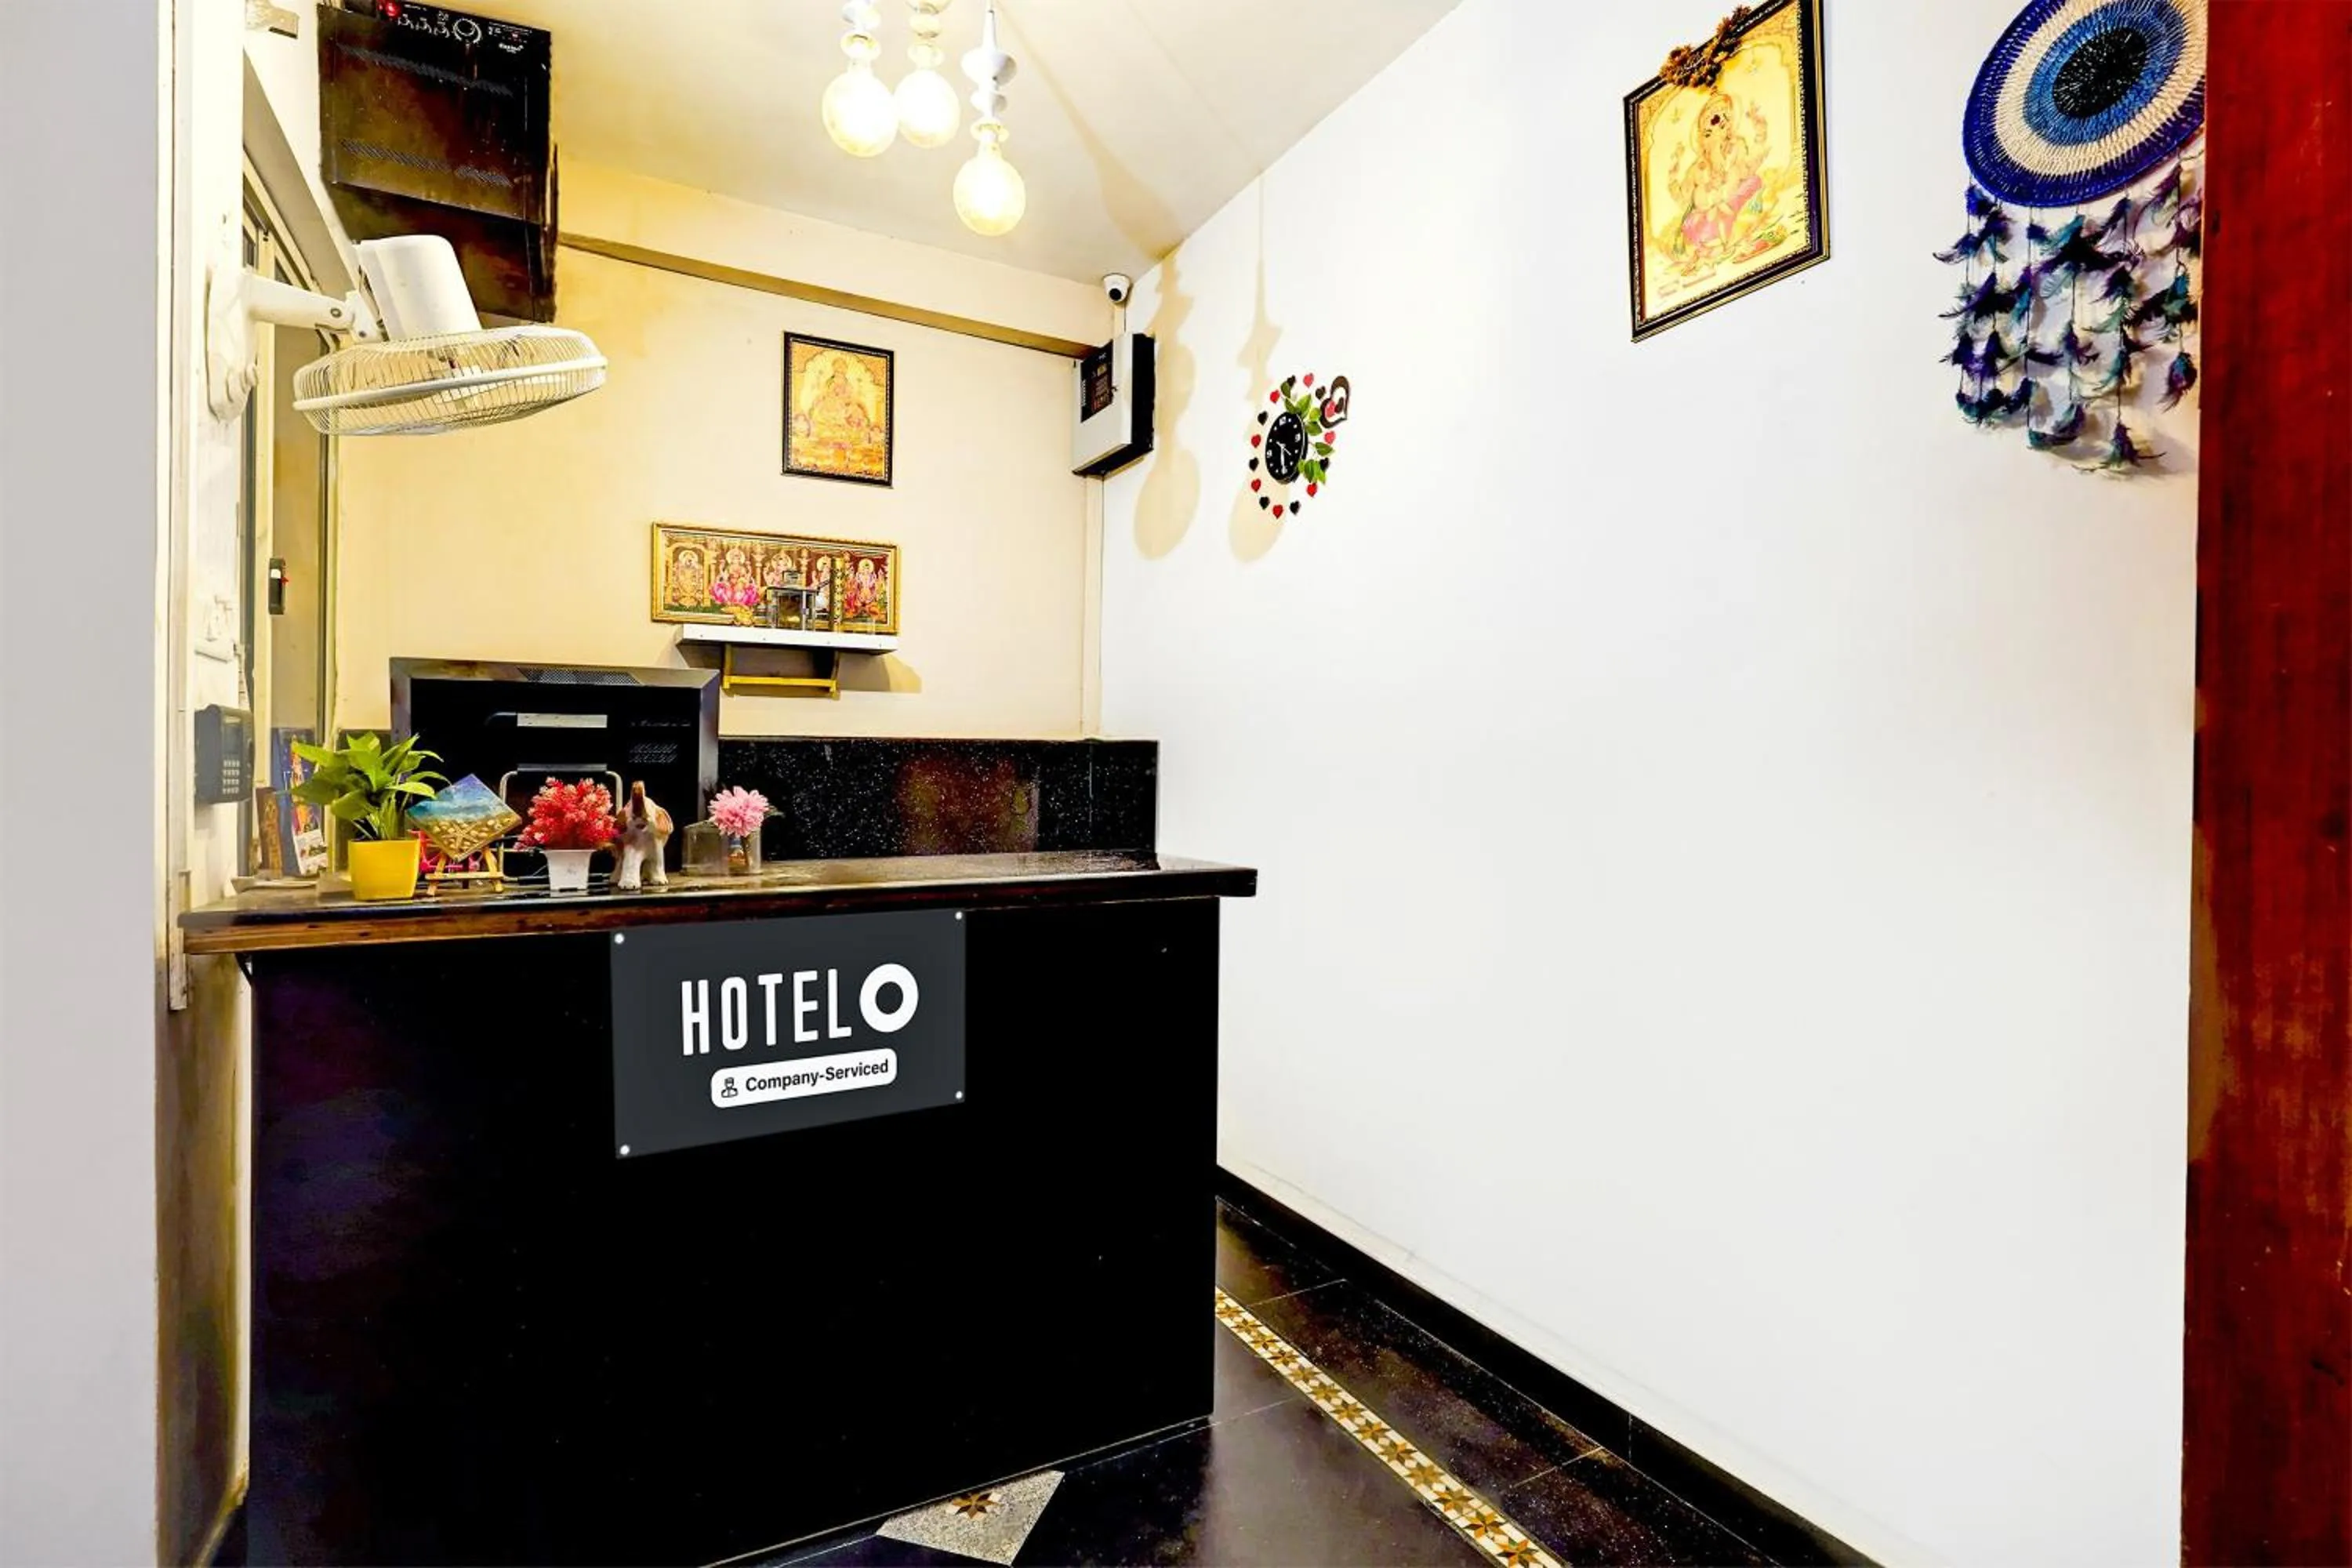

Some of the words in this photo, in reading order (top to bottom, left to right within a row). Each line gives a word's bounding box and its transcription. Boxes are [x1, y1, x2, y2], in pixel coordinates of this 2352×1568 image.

[681, 968, 852, 1056] HOTEL
[859, 964, 919, 1033] O
[746, 1058, 889, 1092] Company-Serviced
